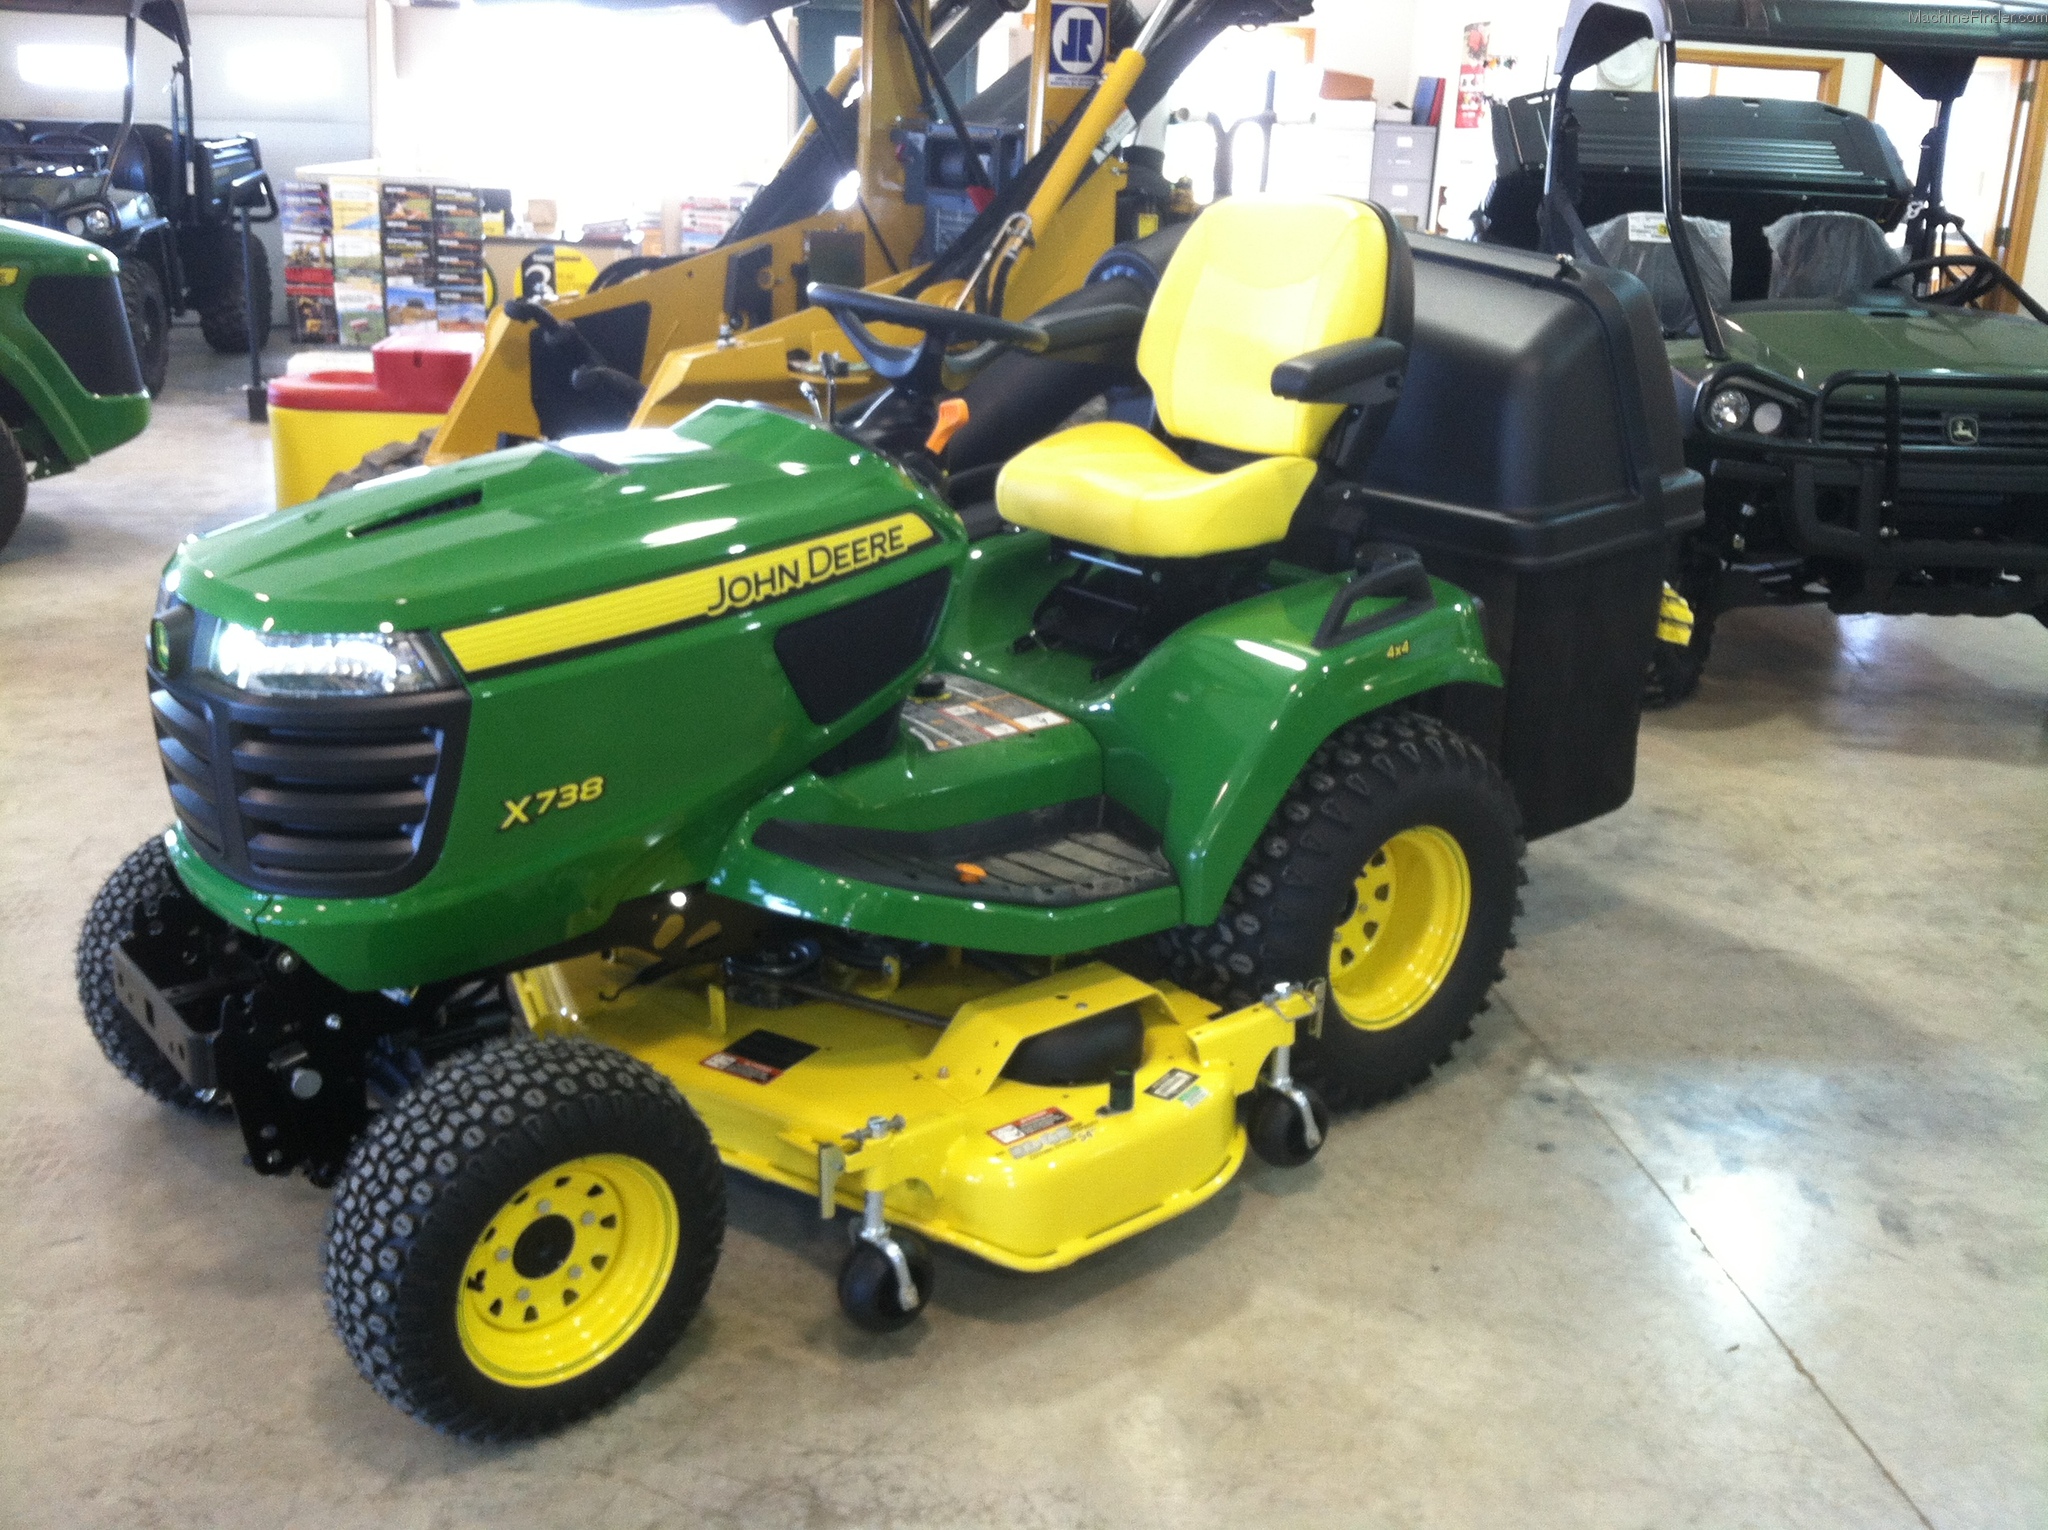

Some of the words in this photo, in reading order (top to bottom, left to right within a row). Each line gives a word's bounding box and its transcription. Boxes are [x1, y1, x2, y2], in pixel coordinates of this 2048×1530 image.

[707, 557, 801, 613] JOHN
[807, 524, 905, 580] DEERE
[1386, 640, 1409, 658] 4x4
[500, 775, 605, 830] X738
